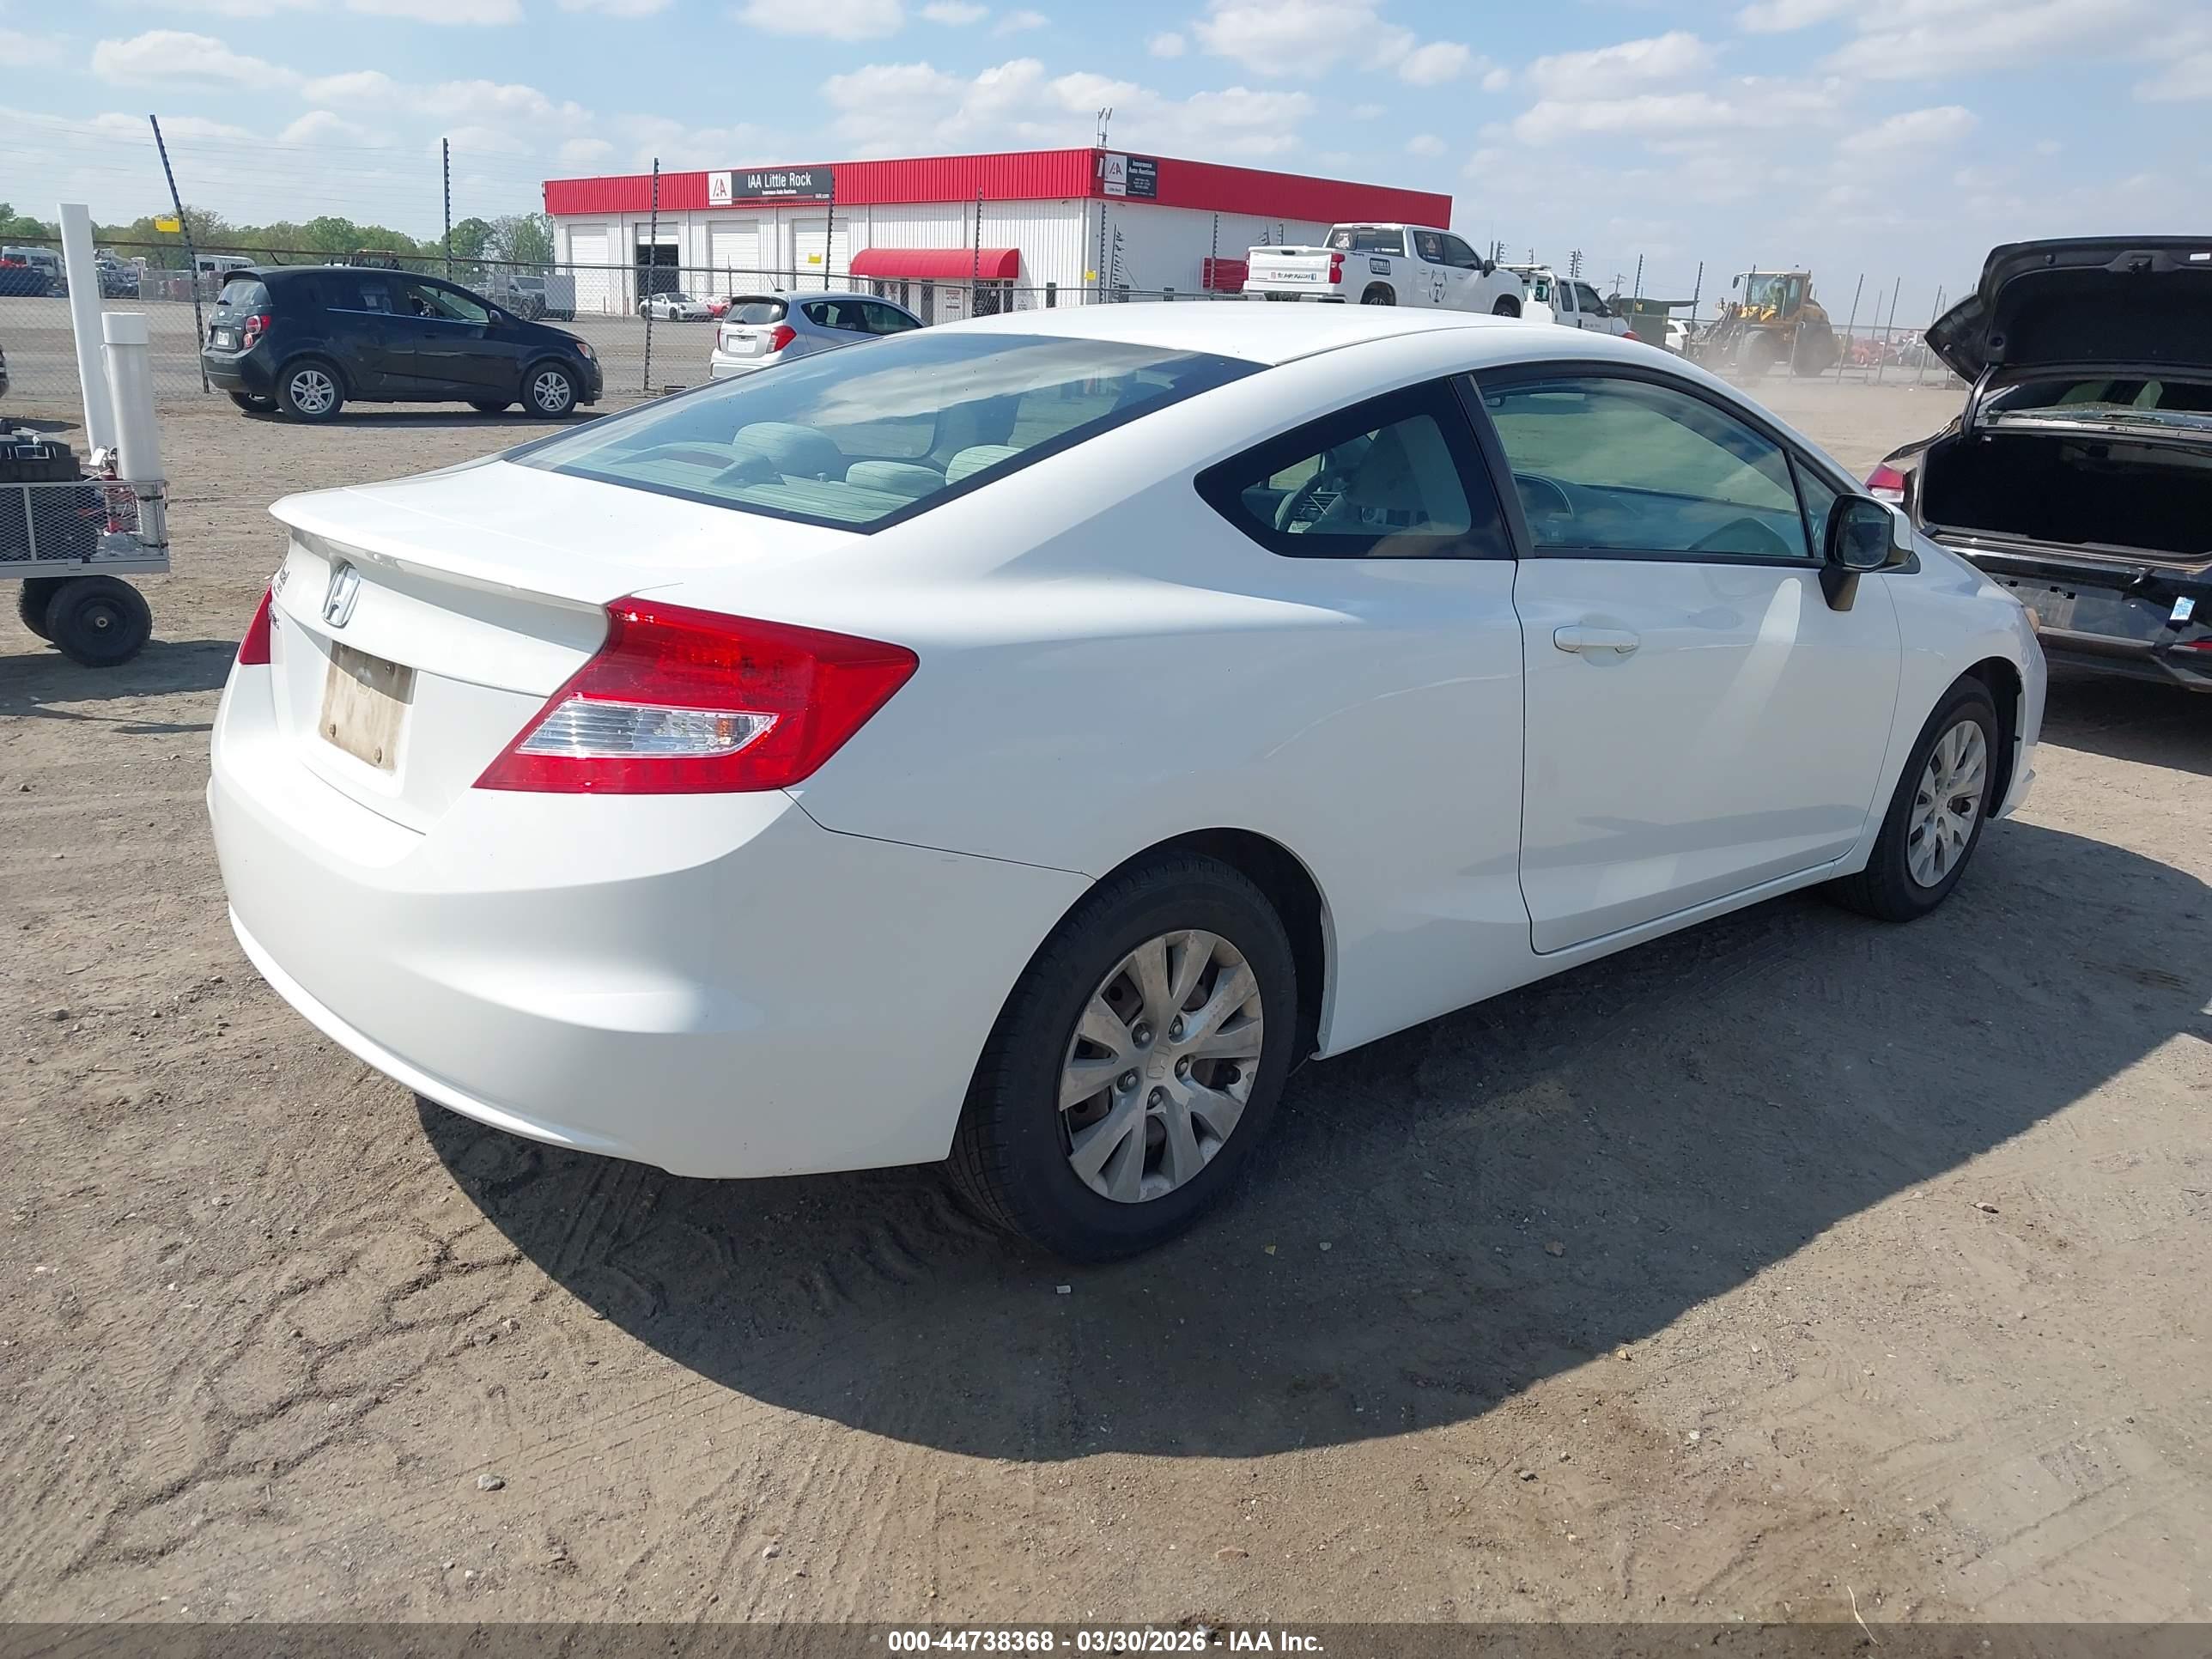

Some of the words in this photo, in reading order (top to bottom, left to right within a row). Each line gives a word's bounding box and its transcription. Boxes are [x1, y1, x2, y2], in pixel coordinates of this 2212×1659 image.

[747, 173, 763, 189] IAA
[764, 173, 787, 188] Little
[789, 171, 812, 186] Rock
